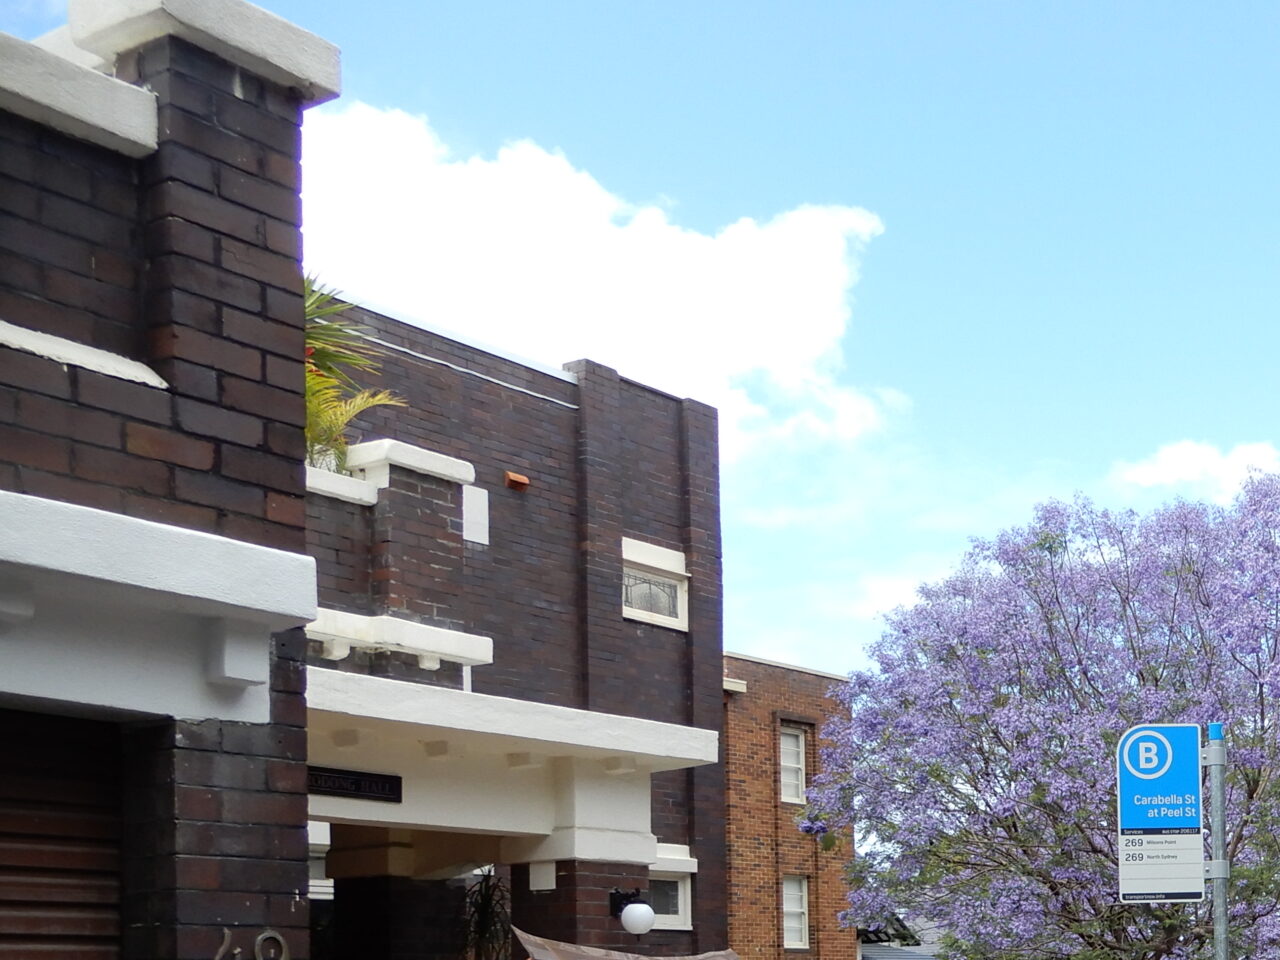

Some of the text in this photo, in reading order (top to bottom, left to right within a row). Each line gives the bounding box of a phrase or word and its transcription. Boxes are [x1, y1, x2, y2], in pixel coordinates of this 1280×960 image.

[1139, 742, 1159, 769] B
[1134, 794, 1196, 805] Carabella St
[1147, 806, 1196, 818] at Peel St
[1124, 838, 1144, 847] 269
[1125, 853, 1144, 862] 269
